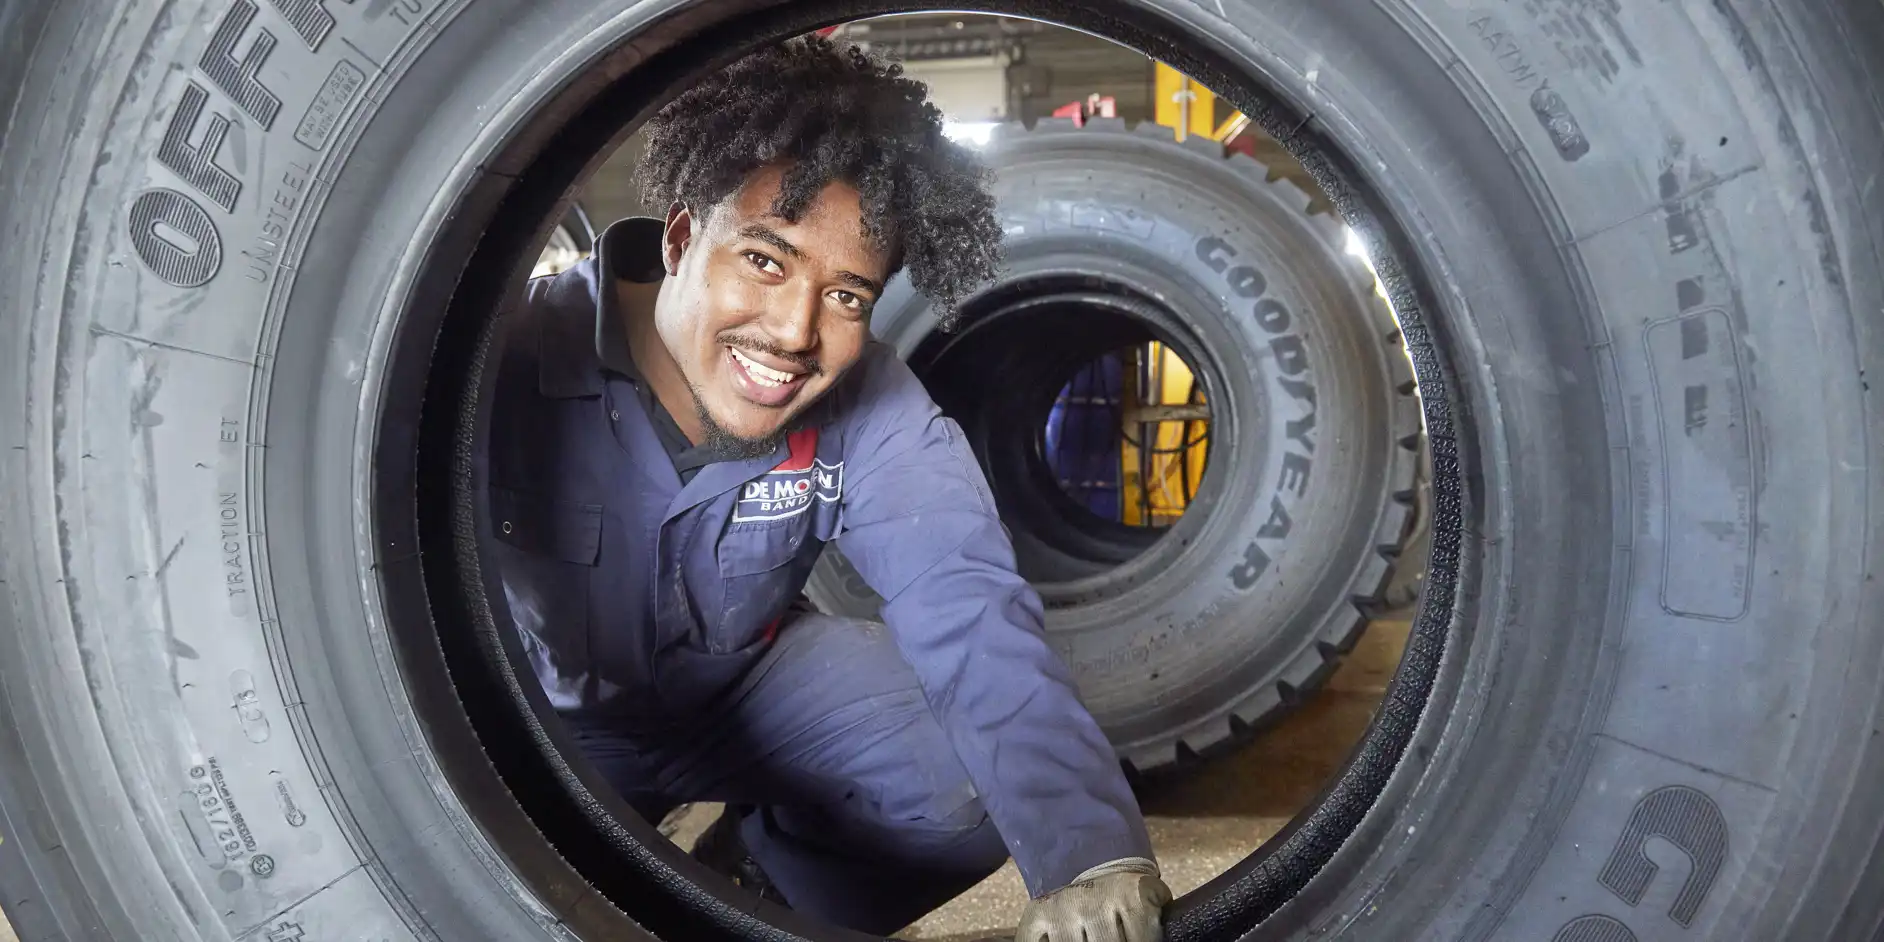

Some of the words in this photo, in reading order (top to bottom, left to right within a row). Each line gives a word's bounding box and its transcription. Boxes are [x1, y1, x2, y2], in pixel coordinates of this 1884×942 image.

[245, 161, 313, 284] UNISTEEL
[1195, 236, 1317, 591] GOODYEAR
[219, 492, 246, 597] TRACTION
[745, 481, 770, 499] DE
